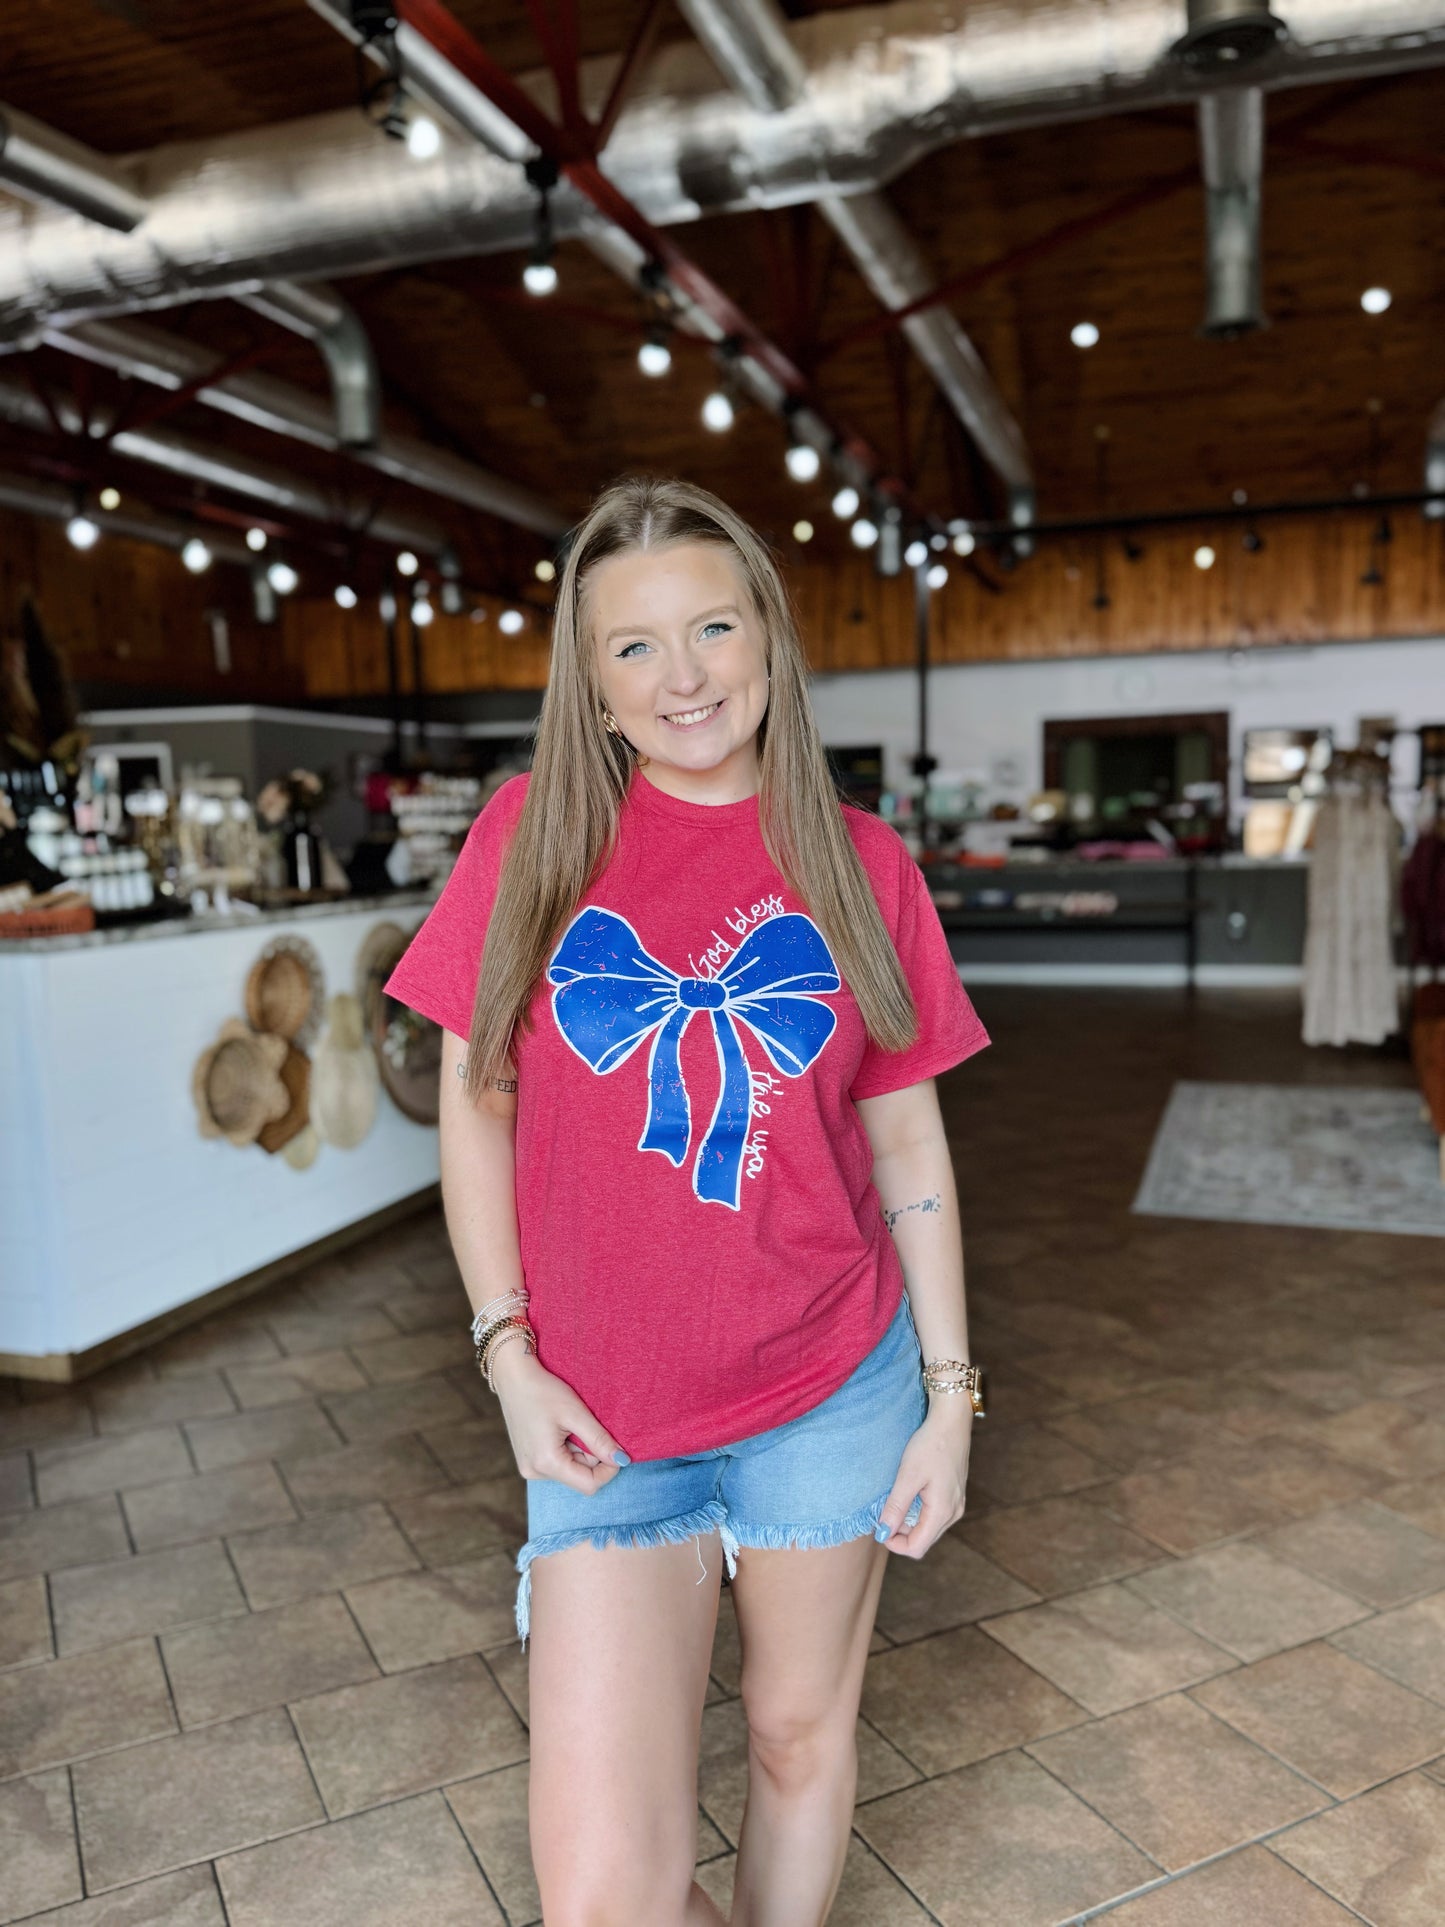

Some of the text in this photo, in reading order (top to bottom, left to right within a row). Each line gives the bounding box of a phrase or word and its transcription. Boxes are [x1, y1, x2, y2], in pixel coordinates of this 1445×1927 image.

[688, 894, 784, 982] God bless
[744, 1071, 784, 1179] the usa
